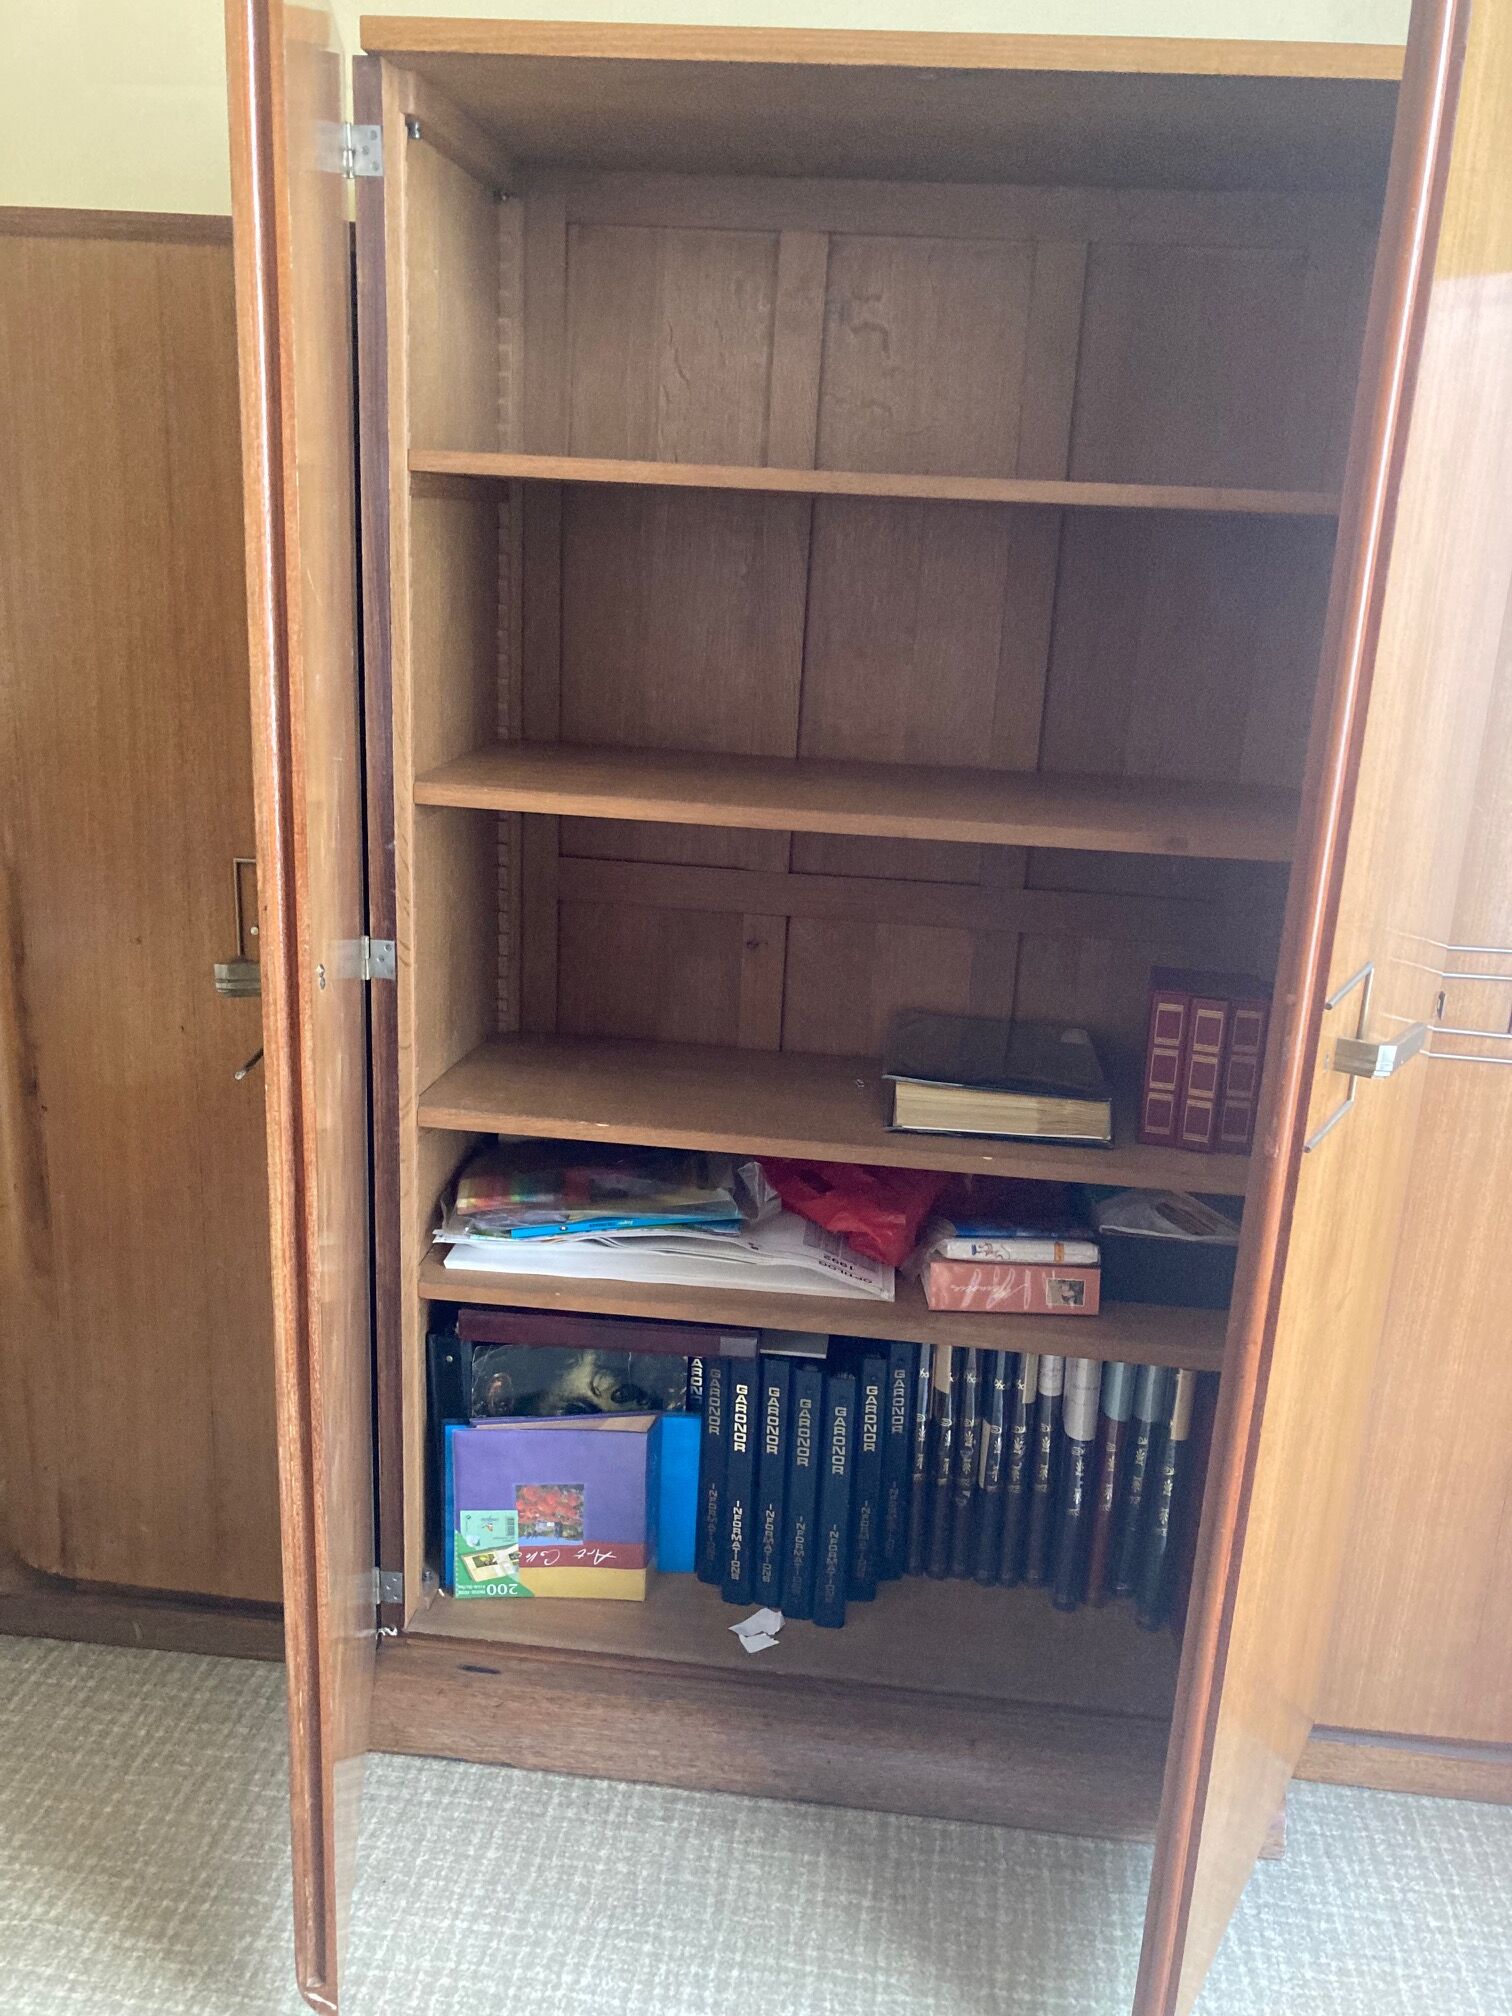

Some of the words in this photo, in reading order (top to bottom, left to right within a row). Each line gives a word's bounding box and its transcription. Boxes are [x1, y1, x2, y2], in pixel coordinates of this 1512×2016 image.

[690, 1356, 704, 1400] ARON
[708, 1368, 721, 1435] GARONOR
[891, 1369, 906, 1434] GARONOR
[733, 1384, 748, 1453] GARONOR
[765, 1387, 780, 1455] GARONOR
[796, 1398, 812, 1467] GARONOR
[831, 1406, 847, 1475] GARONOR
[863, 1385, 879, 1452] GARONOR
[486, 1583, 518, 1596] 200
[574, 1549, 617, 1565] Art
